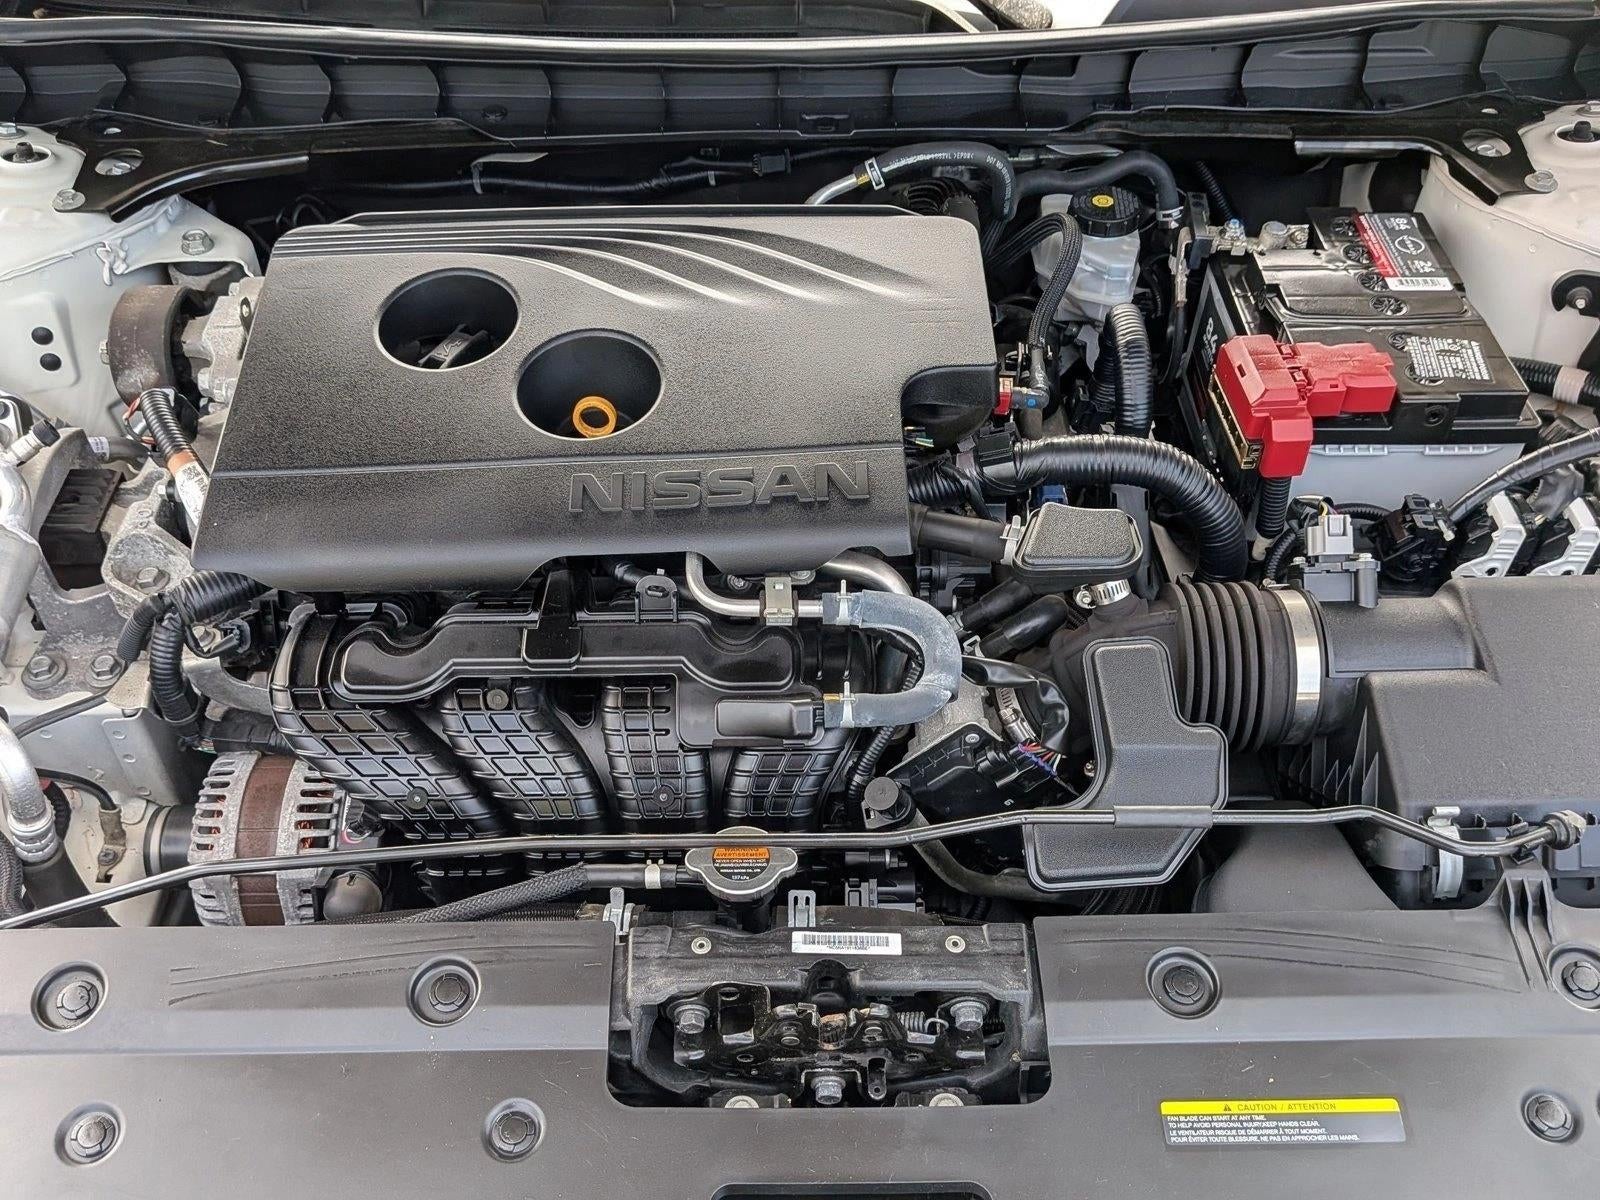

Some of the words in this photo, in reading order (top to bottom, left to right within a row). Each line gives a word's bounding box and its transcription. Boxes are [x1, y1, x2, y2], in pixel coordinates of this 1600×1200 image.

[568, 460, 871, 513] NISSAN
[1237, 1103, 1277, 1111] CAUTION
[1188, 1135, 1208, 1143] ÉVITER
